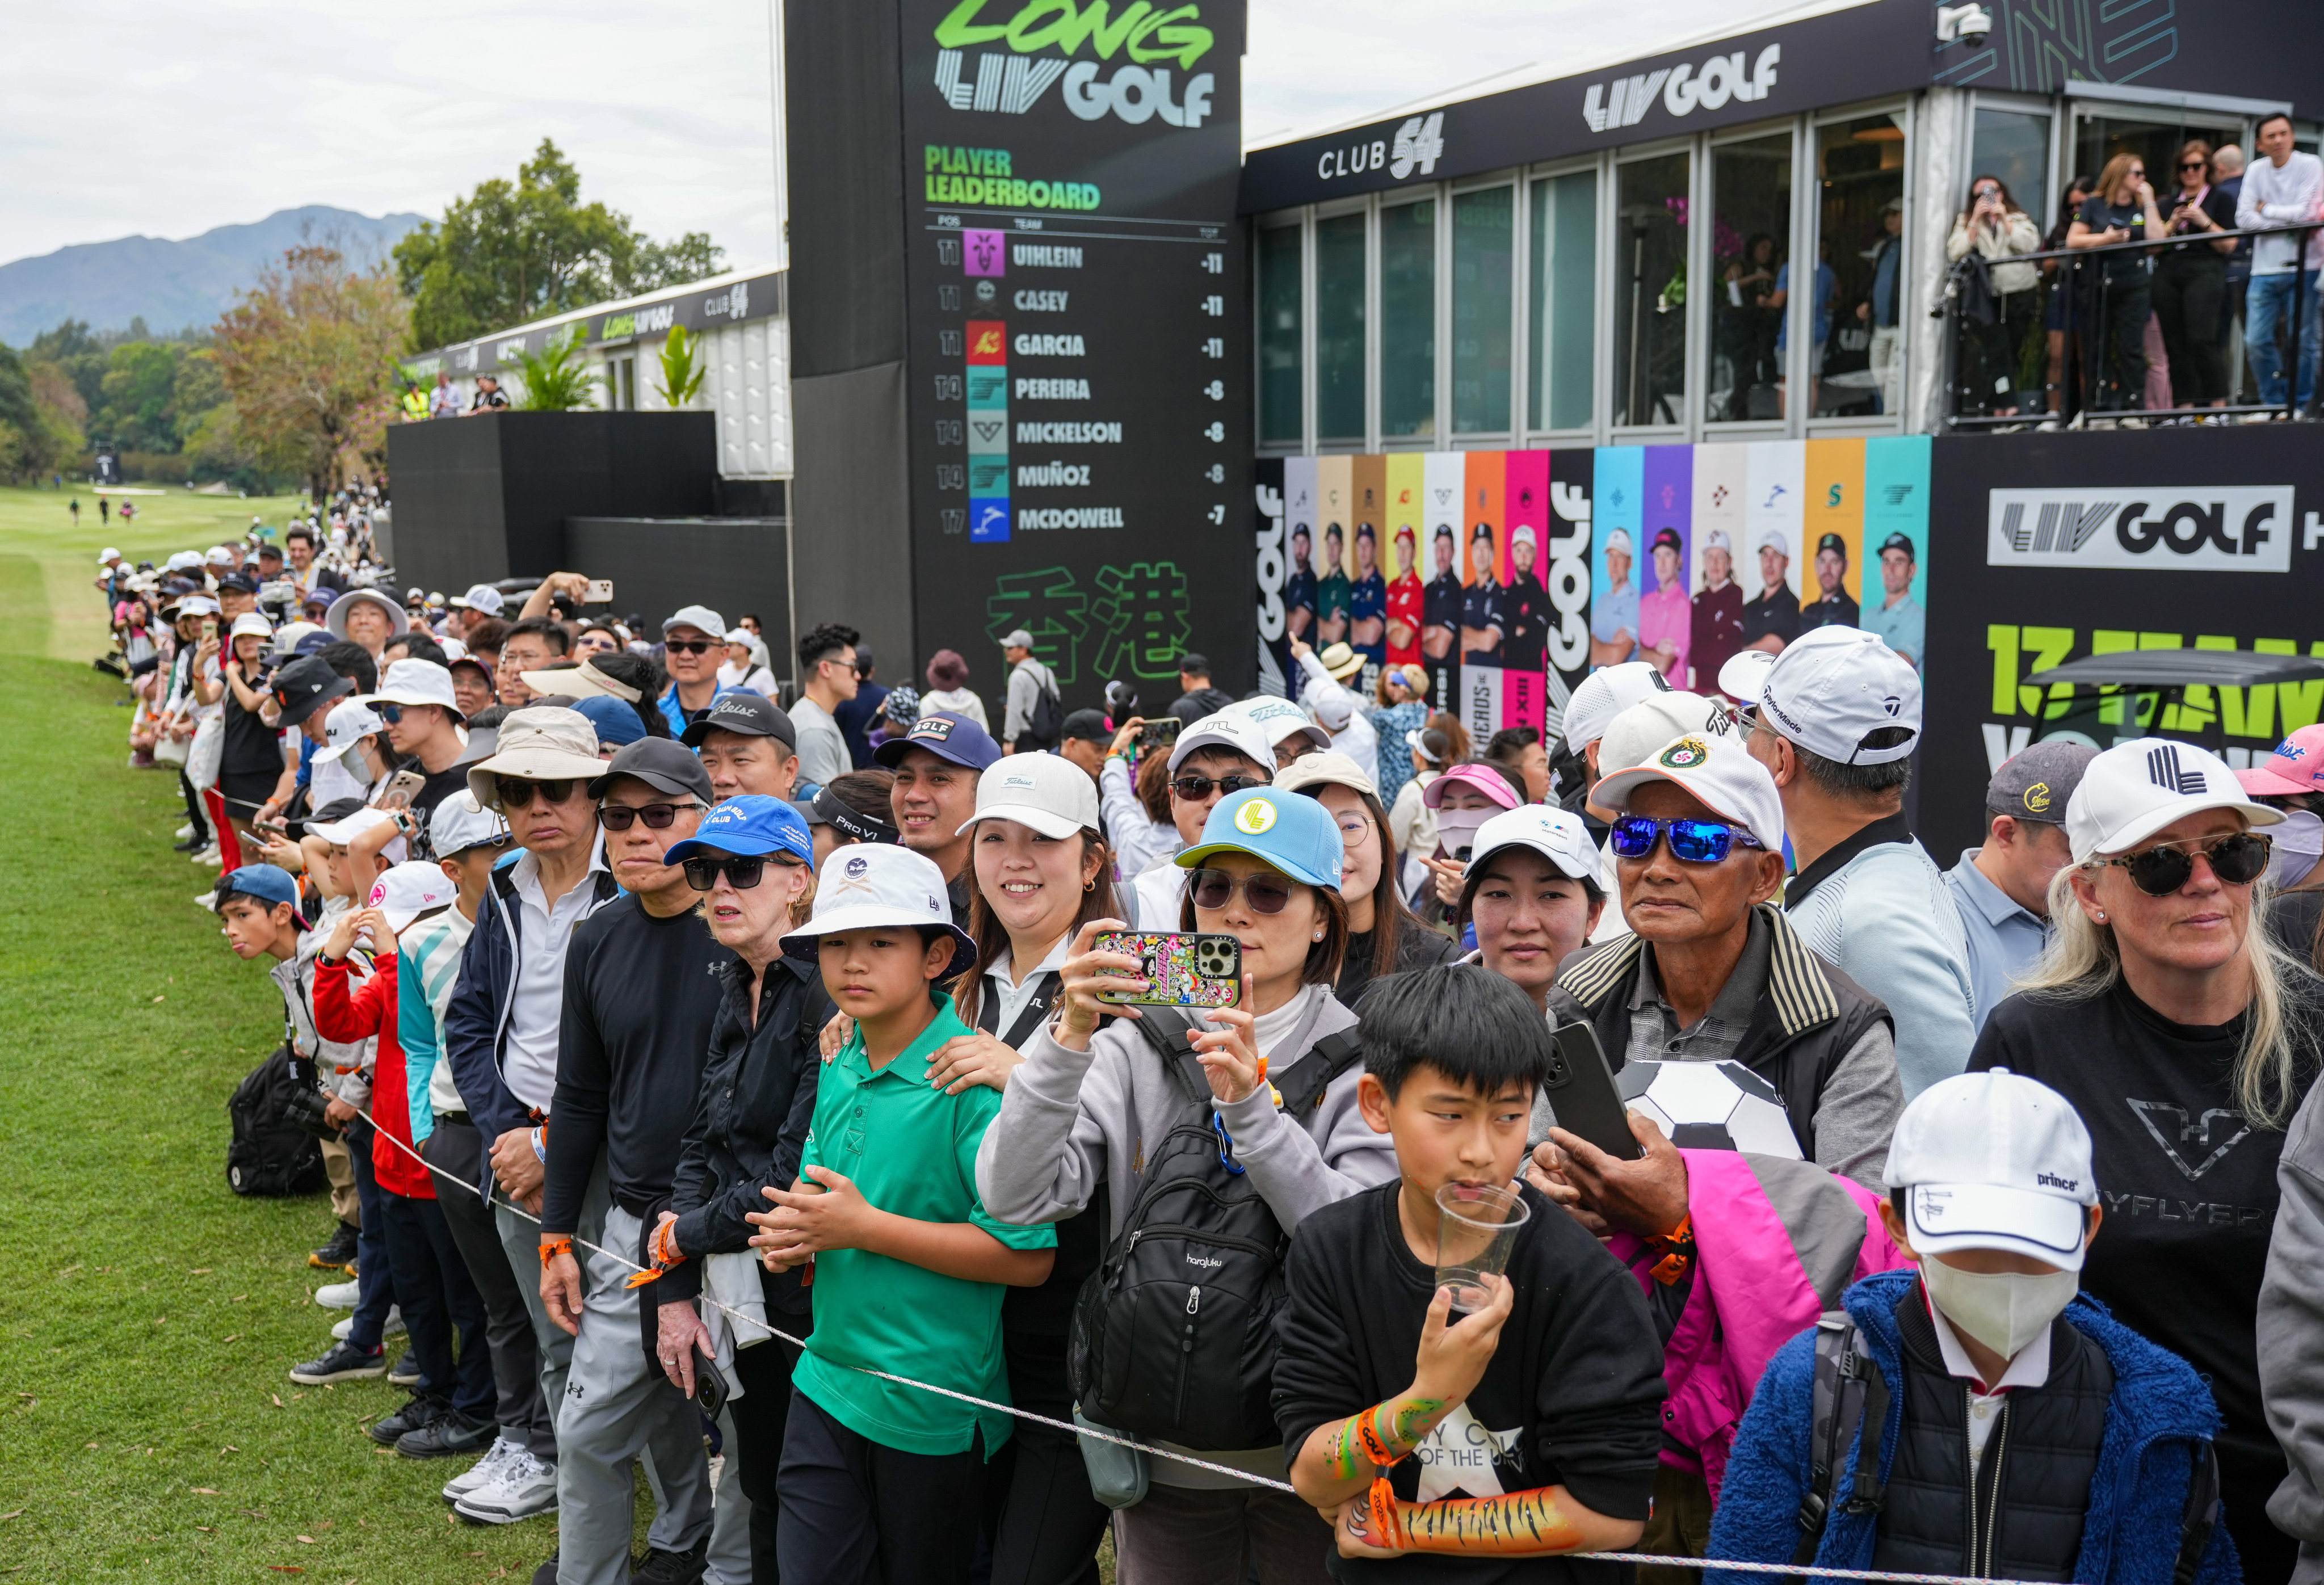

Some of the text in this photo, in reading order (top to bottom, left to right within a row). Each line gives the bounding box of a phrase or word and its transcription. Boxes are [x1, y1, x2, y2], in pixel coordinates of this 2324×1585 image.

[934, 0, 1214, 70] LONG
[1062, 61, 1214, 128] GOLF
[1665, 43, 1780, 117] GOLF
[1318, 112, 1444, 179] CLUB 54
[925, 145, 1012, 177] PLAYER
[925, 175, 1101, 211] LEADERBOARD
[938, 215, 961, 226] POS
[1014, 218, 1043, 230] TEAM
[1013, 245, 1083, 268] UIHLEIN
[1201, 253, 1223, 274] -11
[704, 294, 729, 316] CLUB
[1014, 290, 1069, 312] CASEY
[1201, 296, 1223, 316] -11
[1014, 334, 1085, 356] GARCIA
[1201, 338, 1223, 358] -11
[934, 375, 1224, 401] T4 PEREIRA -8
[935, 420, 1224, 445] T4 MICKELSON -8
[937, 460, 1224, 490] T4 MUÑOZ -8
[1019, 508, 1124, 529] MCDOWELL
[1208, 505, 1225, 525] -7
[2116, 500, 2276, 555] GOLF
[1255, 484, 1285, 642] GOLF
[1547, 481, 1592, 672] GOLF
[985, 561, 1193, 686] 香港
[1763, 685, 1802, 734] TaylorMade
[1003, 777, 1033, 786] Titleist
[716, 805, 733, 814] SUM
[730, 806, 747, 821] GOLF
[836, 815, 878, 840] PRO V1
[1542, 829, 1567, 840] Motorsport
[2037, 1172, 2075, 1191] prince
[2095, 1189, 2279, 1229] YFLYER
[1186, 1252, 1222, 1269] harajuku
[1363, 1427, 1384, 1456] GOLF
[1418, 1448, 1443, 1465] OF
[1449, 1449, 1483, 1466] THE
[1373, 1492, 1385, 1523] 2025
